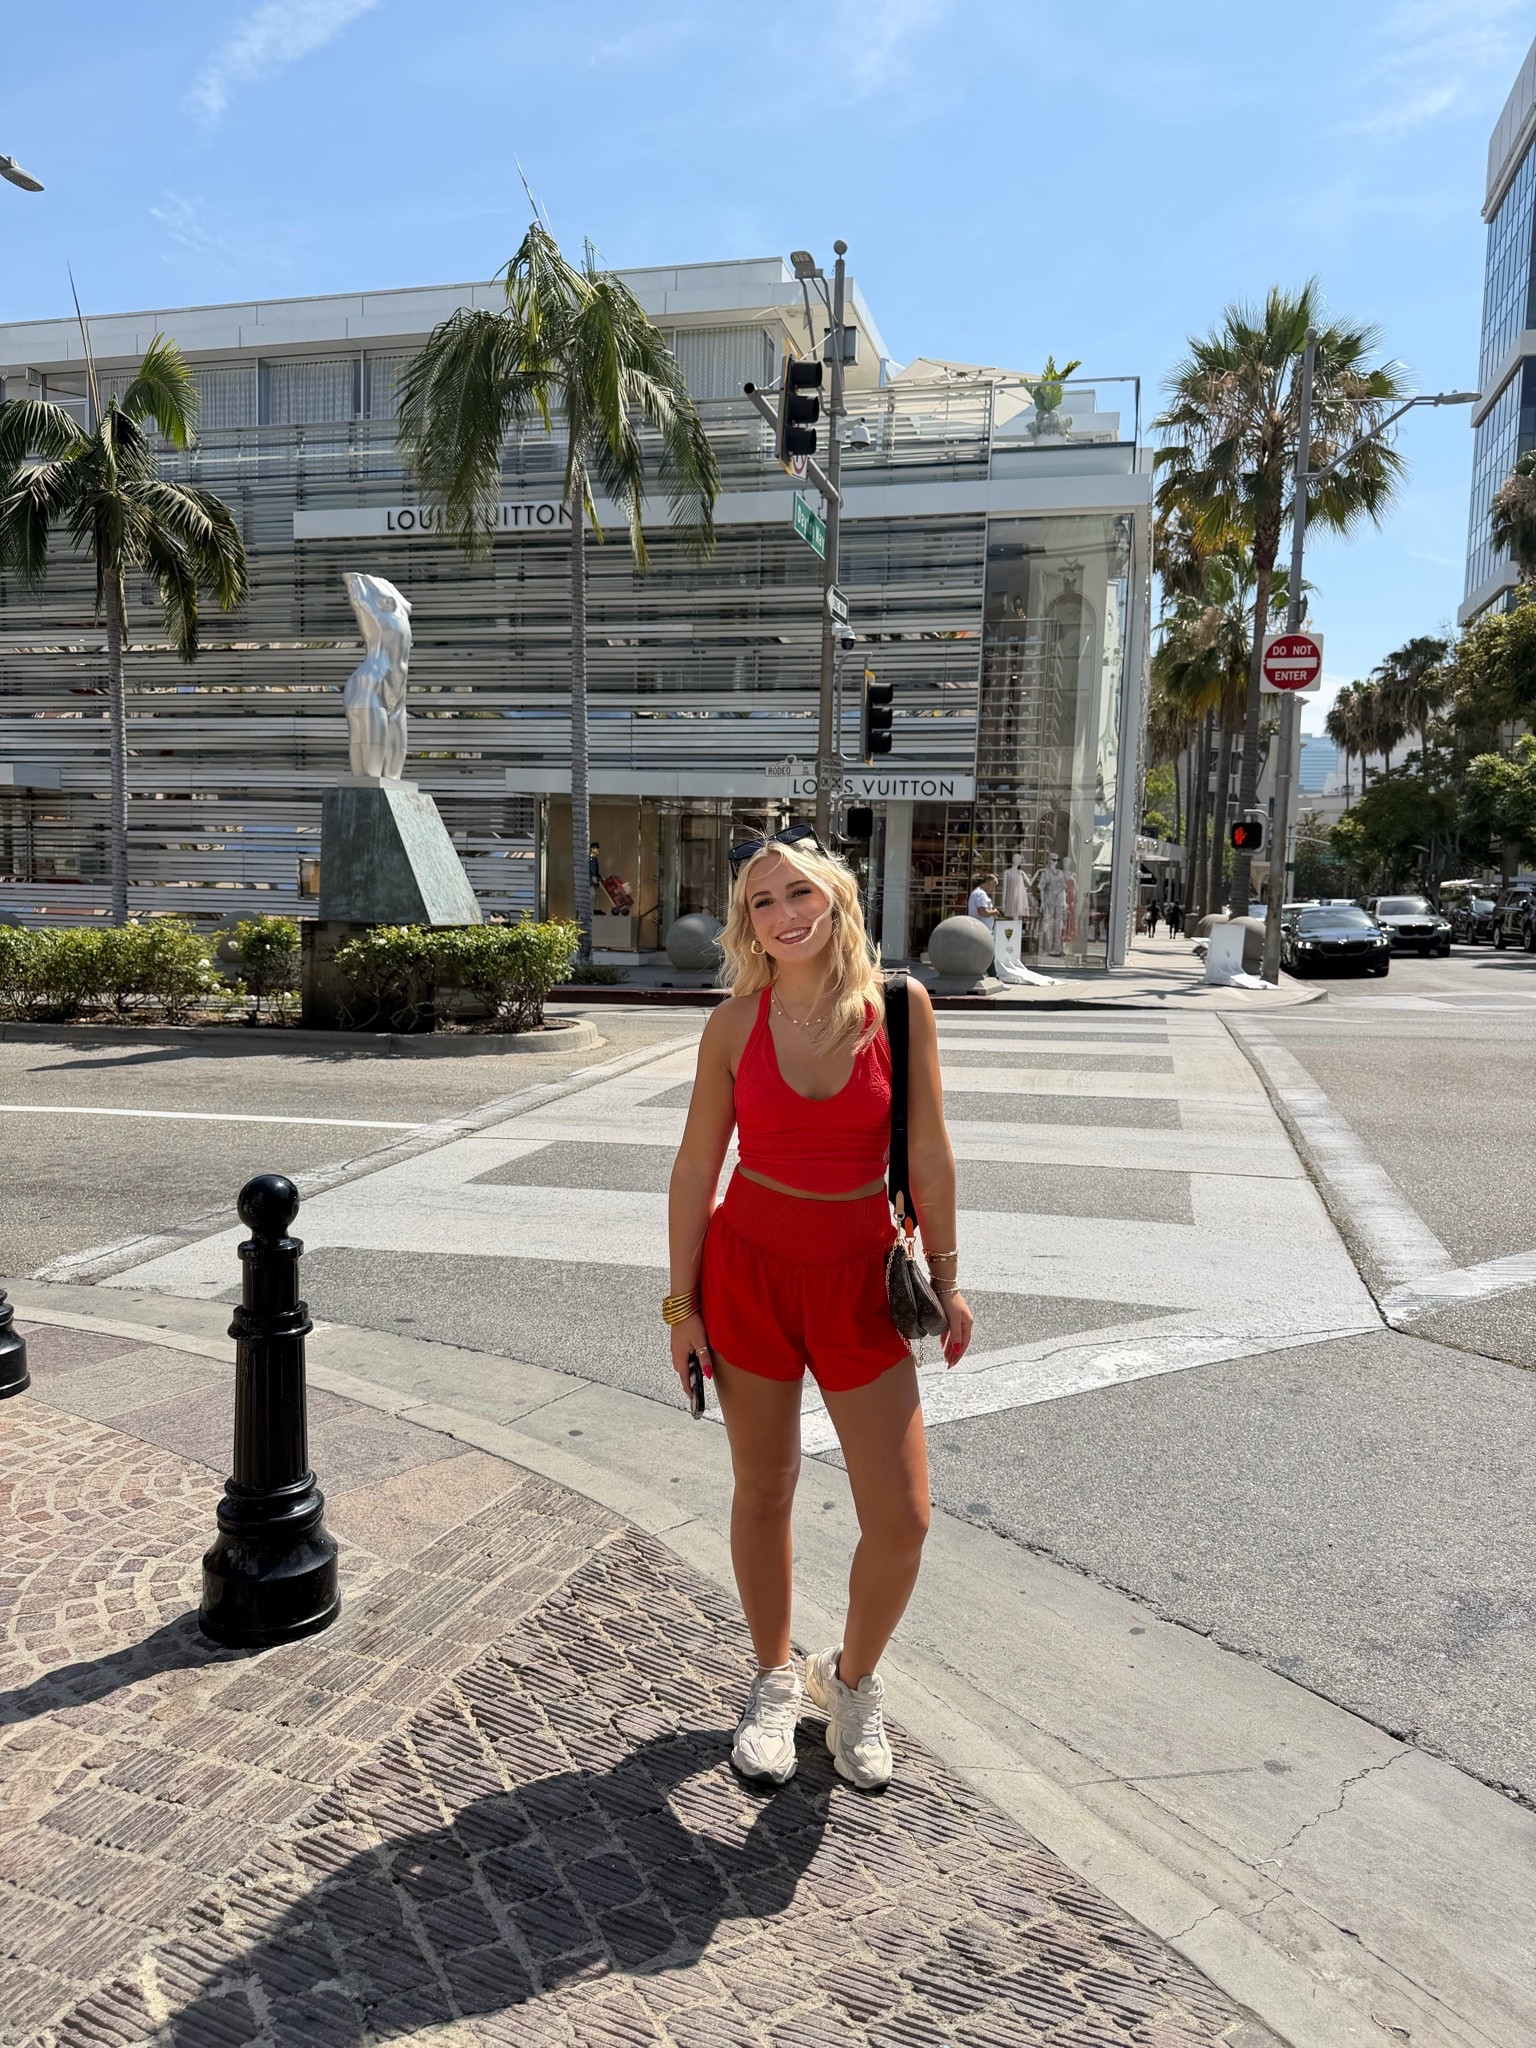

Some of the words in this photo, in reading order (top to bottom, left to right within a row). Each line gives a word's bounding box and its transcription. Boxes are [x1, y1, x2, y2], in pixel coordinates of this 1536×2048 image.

[472, 504, 573, 526] UITTON
[1272, 645, 1287, 656] DO
[1292, 645, 1313, 656] NOT
[1274, 671, 1307, 681] ENTER
[768, 766, 791, 776] RODEO
[821, 776, 829, 787] OK
[794, 779, 853, 795] LOS
[863, 779, 954, 796] VUITTON
